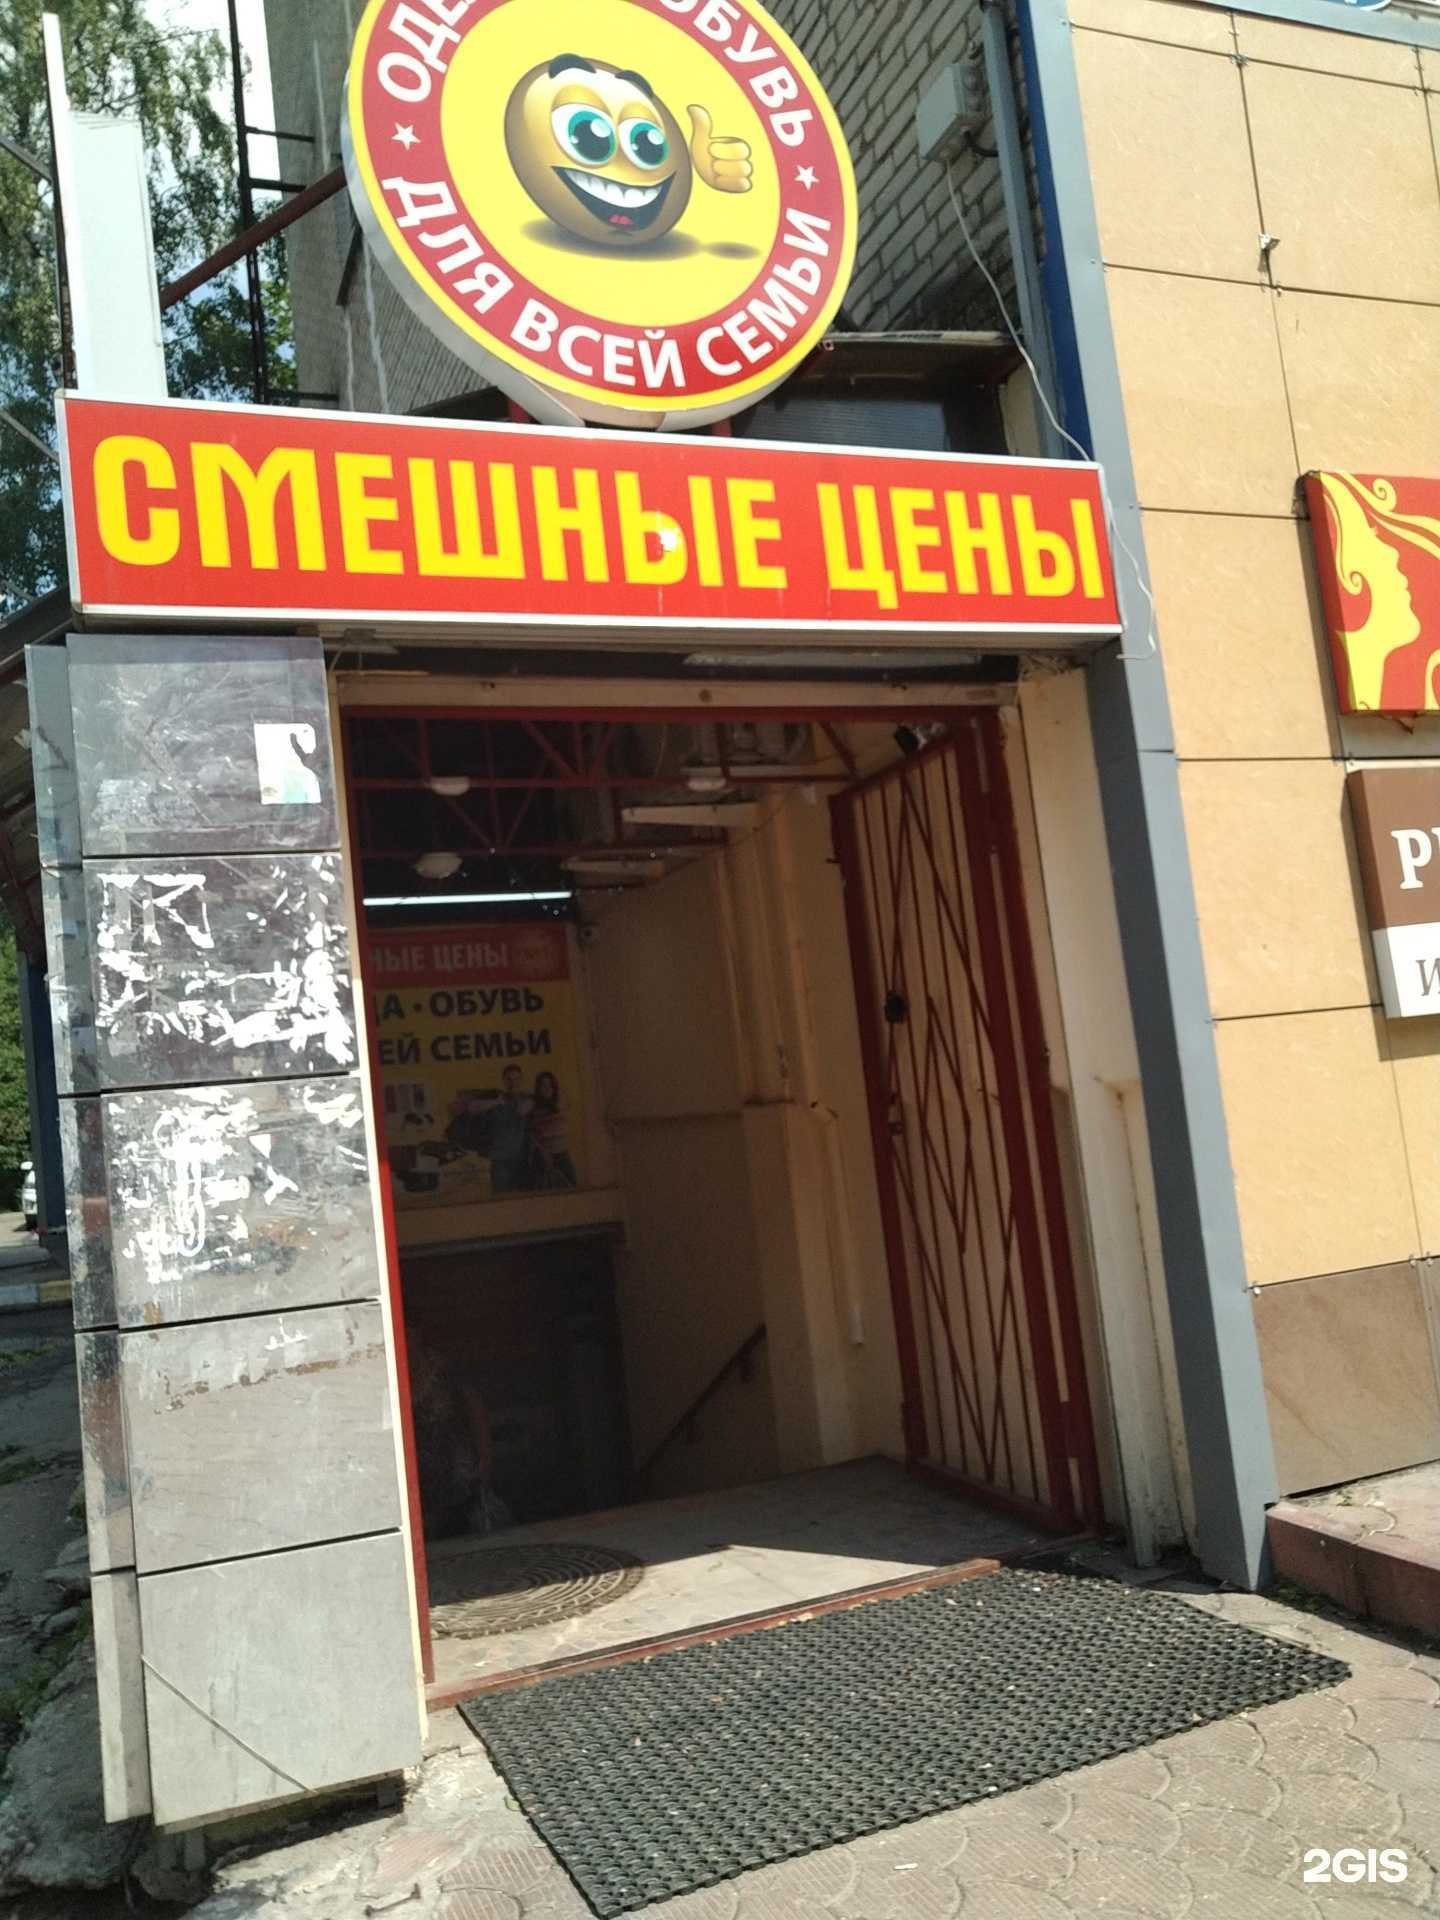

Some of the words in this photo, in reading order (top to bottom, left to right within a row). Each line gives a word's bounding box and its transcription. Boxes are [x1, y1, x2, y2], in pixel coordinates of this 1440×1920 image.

[383, 176, 514, 314] ДЛЯ
[510, 299, 686, 389] ВСЕЙ
[696, 208, 832, 377] СЕМЬИ
[92, 434, 788, 590] СМЕШНЫЕ
[816, 481, 1105, 610] ЦЕНЫ
[431, 942, 510, 974] ЦЕНЫ
[429, 986, 545, 1018] ОБУВЬ
[431, 1028, 552, 1062] СЕМЬИ
